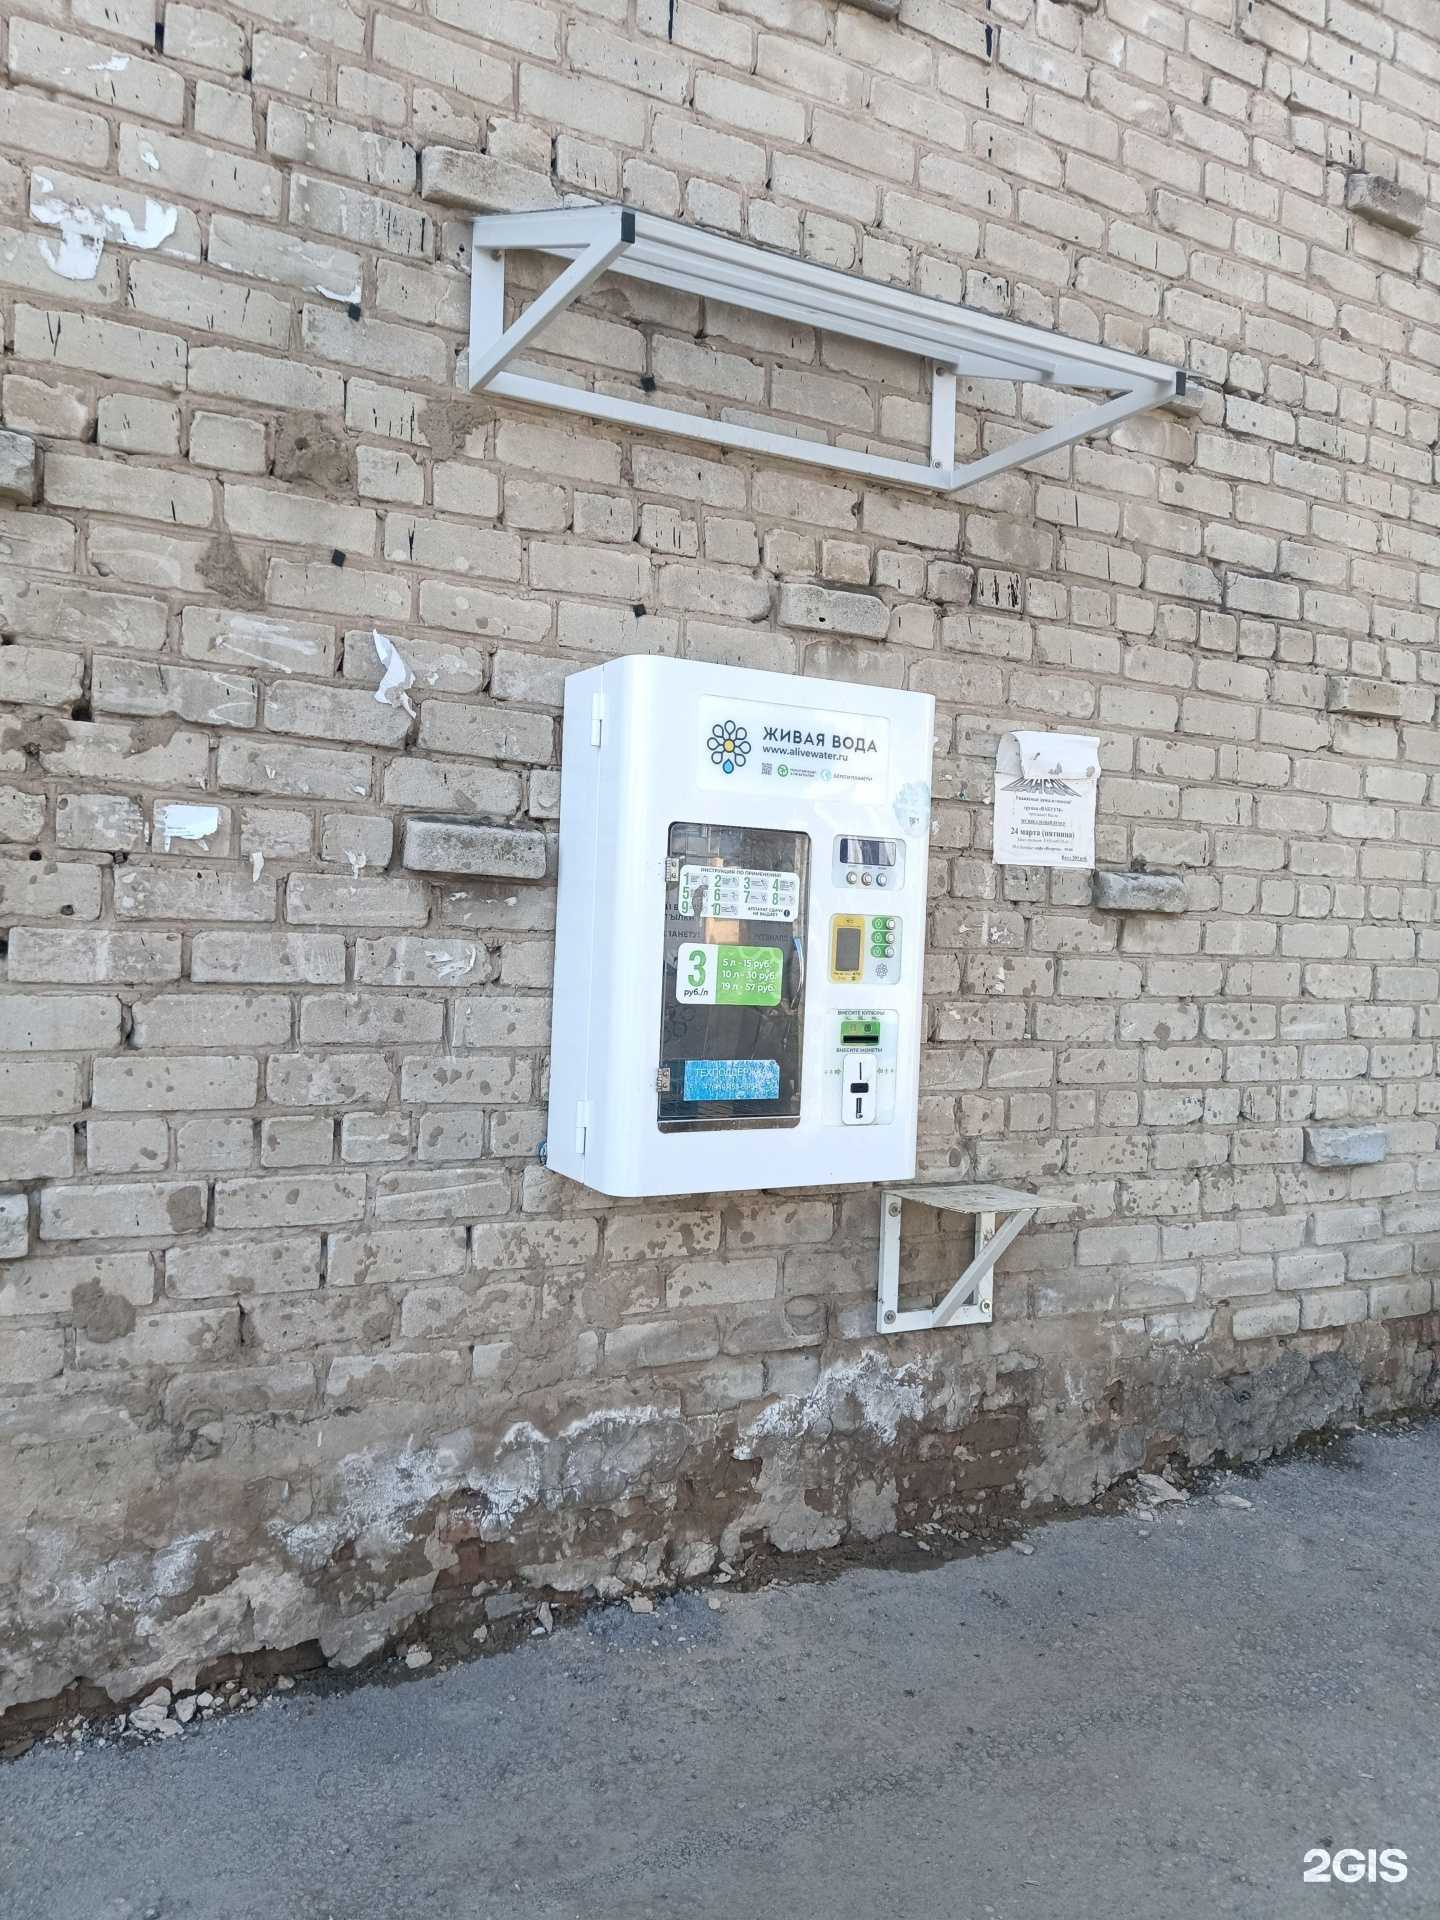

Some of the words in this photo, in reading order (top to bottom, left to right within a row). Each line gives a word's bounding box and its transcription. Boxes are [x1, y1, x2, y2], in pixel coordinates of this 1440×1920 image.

[763, 726, 825, 747] ЖИВАЯ
[832, 735, 878, 753] ВОДА
[762, 745, 848, 761] www.alivewater.ru
[1010, 827, 1018, 835] 24
[1020, 829, 1040, 838] марта
[1041, 829, 1075, 839] (пятница)
[714, 875, 720, 888] 2
[743, 877, 750, 889] 3
[772, 879, 779, 891] 4
[682, 887, 689, 899] 5
[714, 889, 720, 901] 6
[743, 891, 750, 903] 7
[772, 893, 779, 905] 8
[681, 901, 689, 913] 9
[711, 903, 720, 916] 10
[687, 950, 706, 987] 3
[743, 959, 752, 967] 15
[753, 959, 771, 969] руб.
[722, 969, 732, 978] 10
[759, 971, 777, 980] руб.
[683, 988, 709, 997] руб./л
[721, 982, 731, 990] 19
[745, 983, 755, 992] 57
[757, 983, 775, 992] руб.
